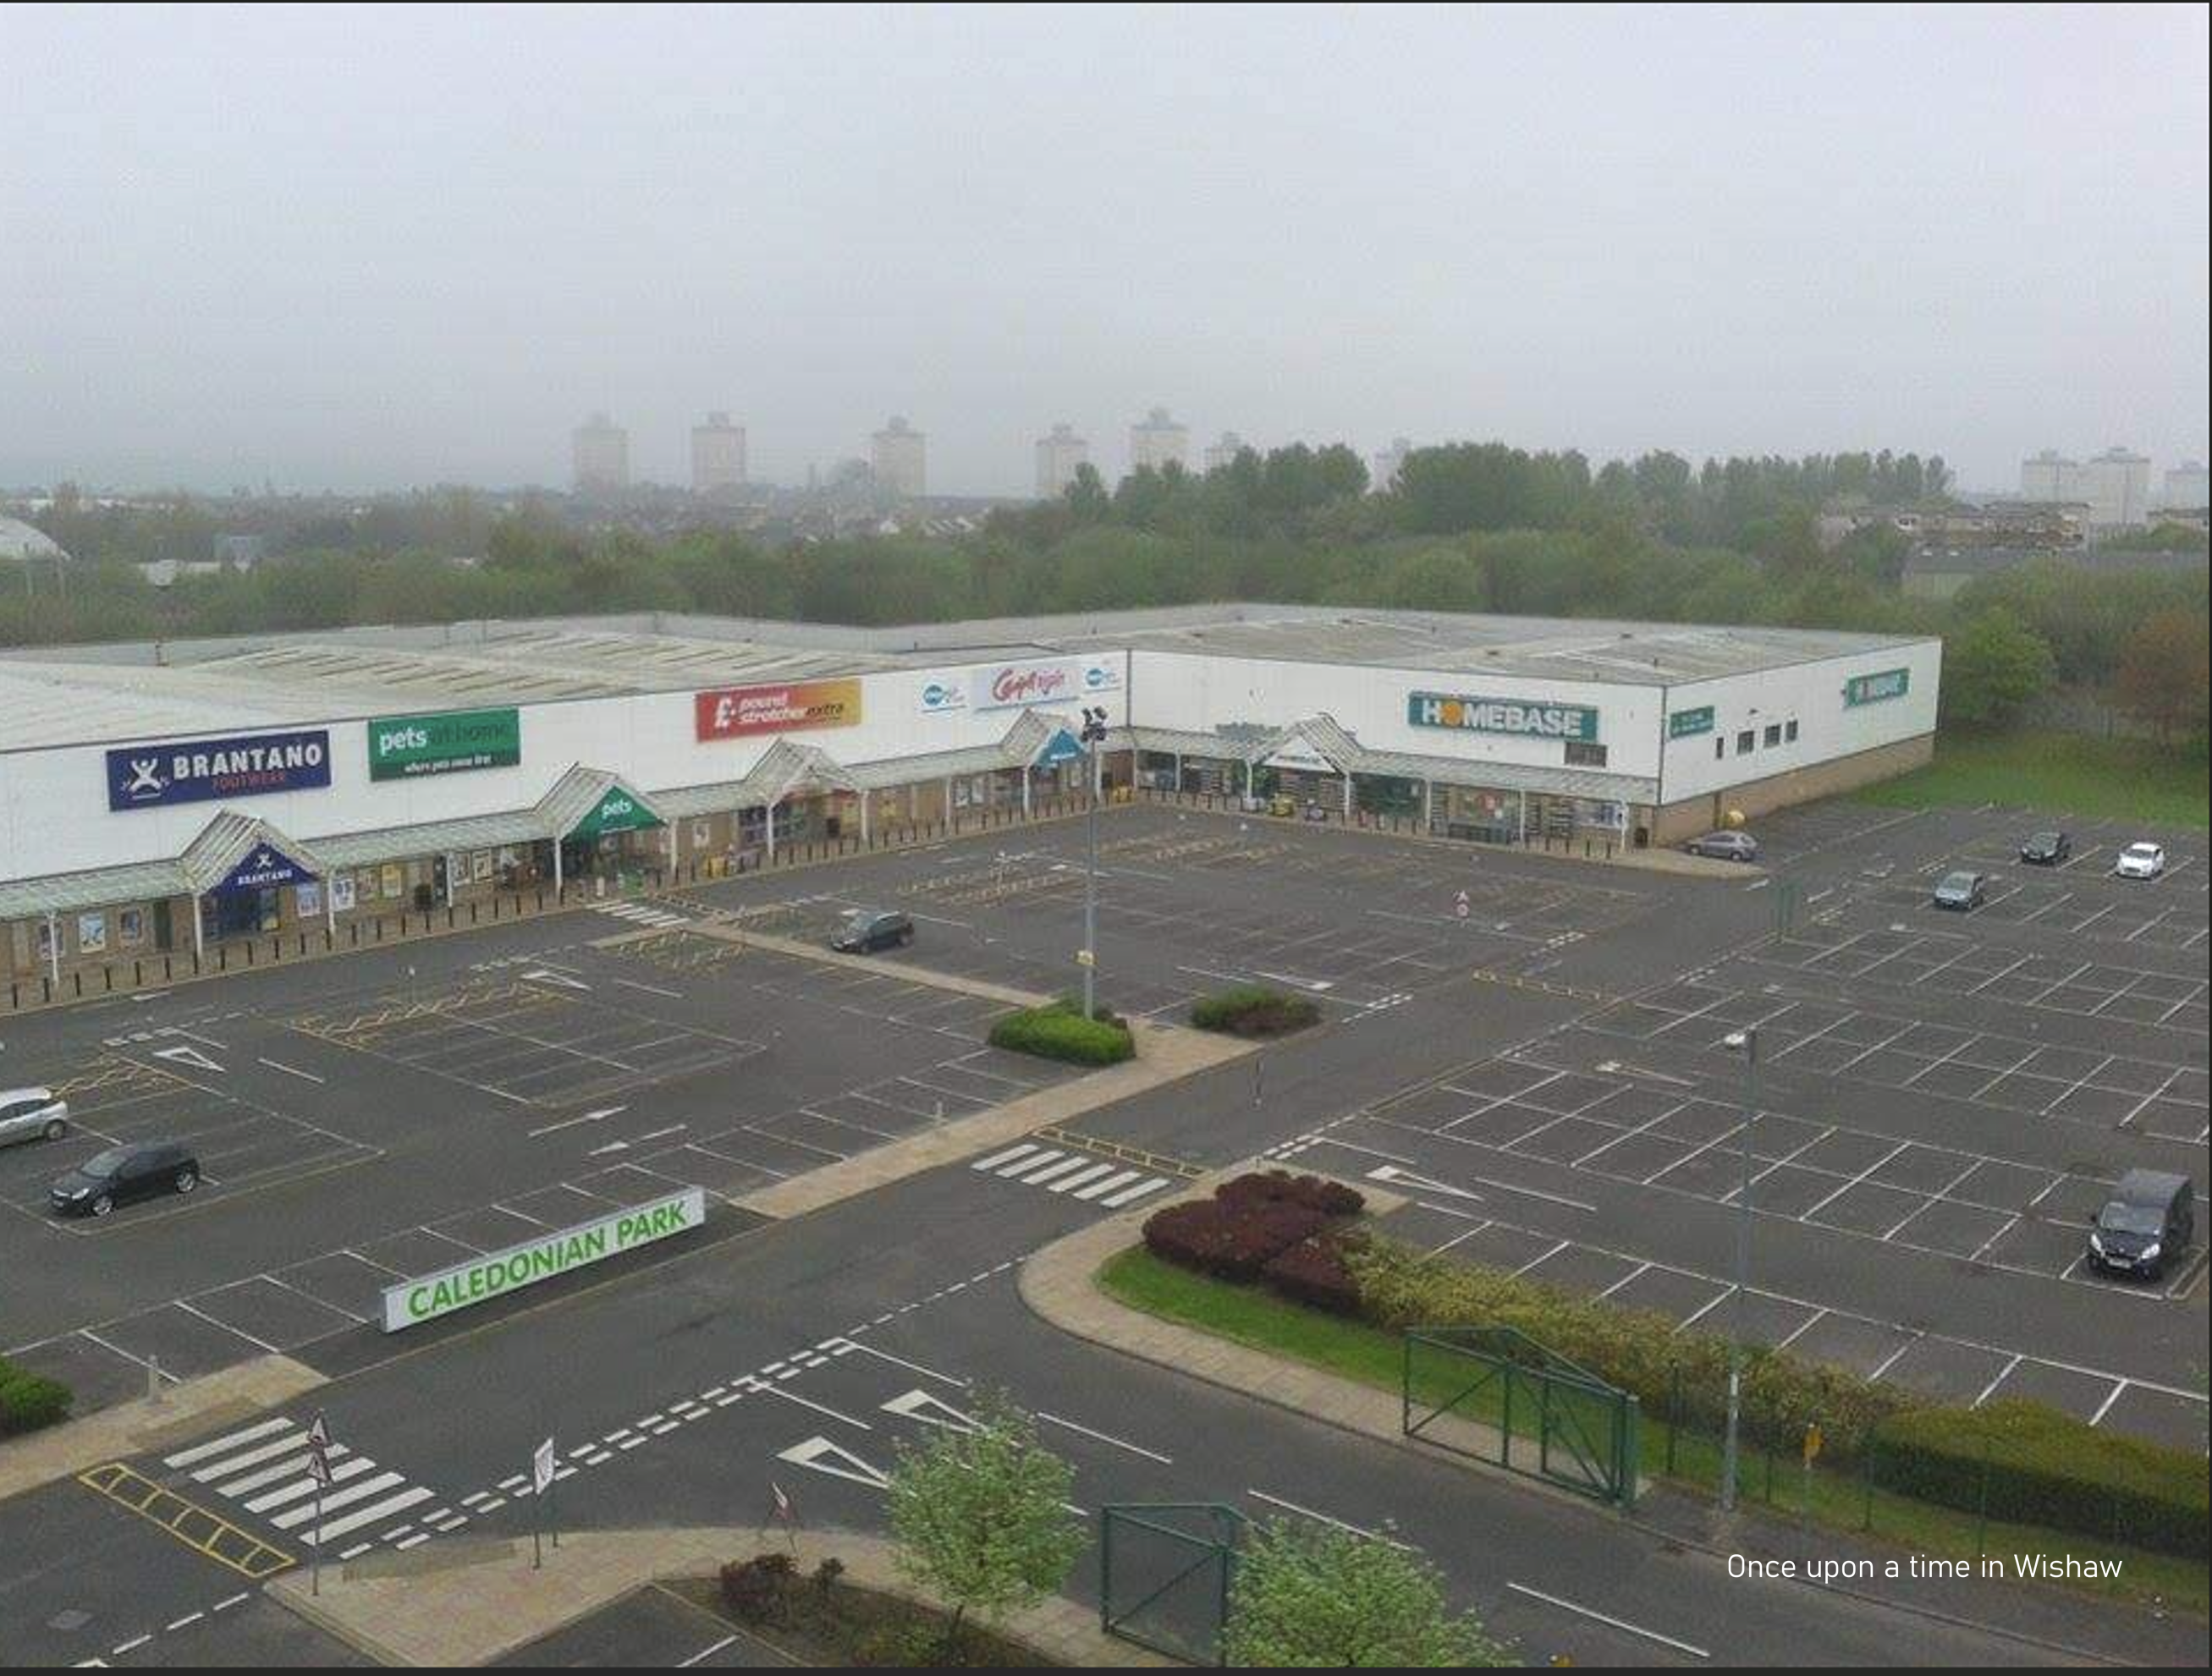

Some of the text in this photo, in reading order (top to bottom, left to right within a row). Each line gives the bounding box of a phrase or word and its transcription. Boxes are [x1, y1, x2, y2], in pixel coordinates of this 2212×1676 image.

[1422, 699, 1582, 736] HOMEBASE
[380, 726, 427, 756] pets
[173, 744, 322, 780] BRANTANO
[238, 868, 293, 887] BRANTANO
[408, 1200, 687, 1318] CALEDONIAN PARK
